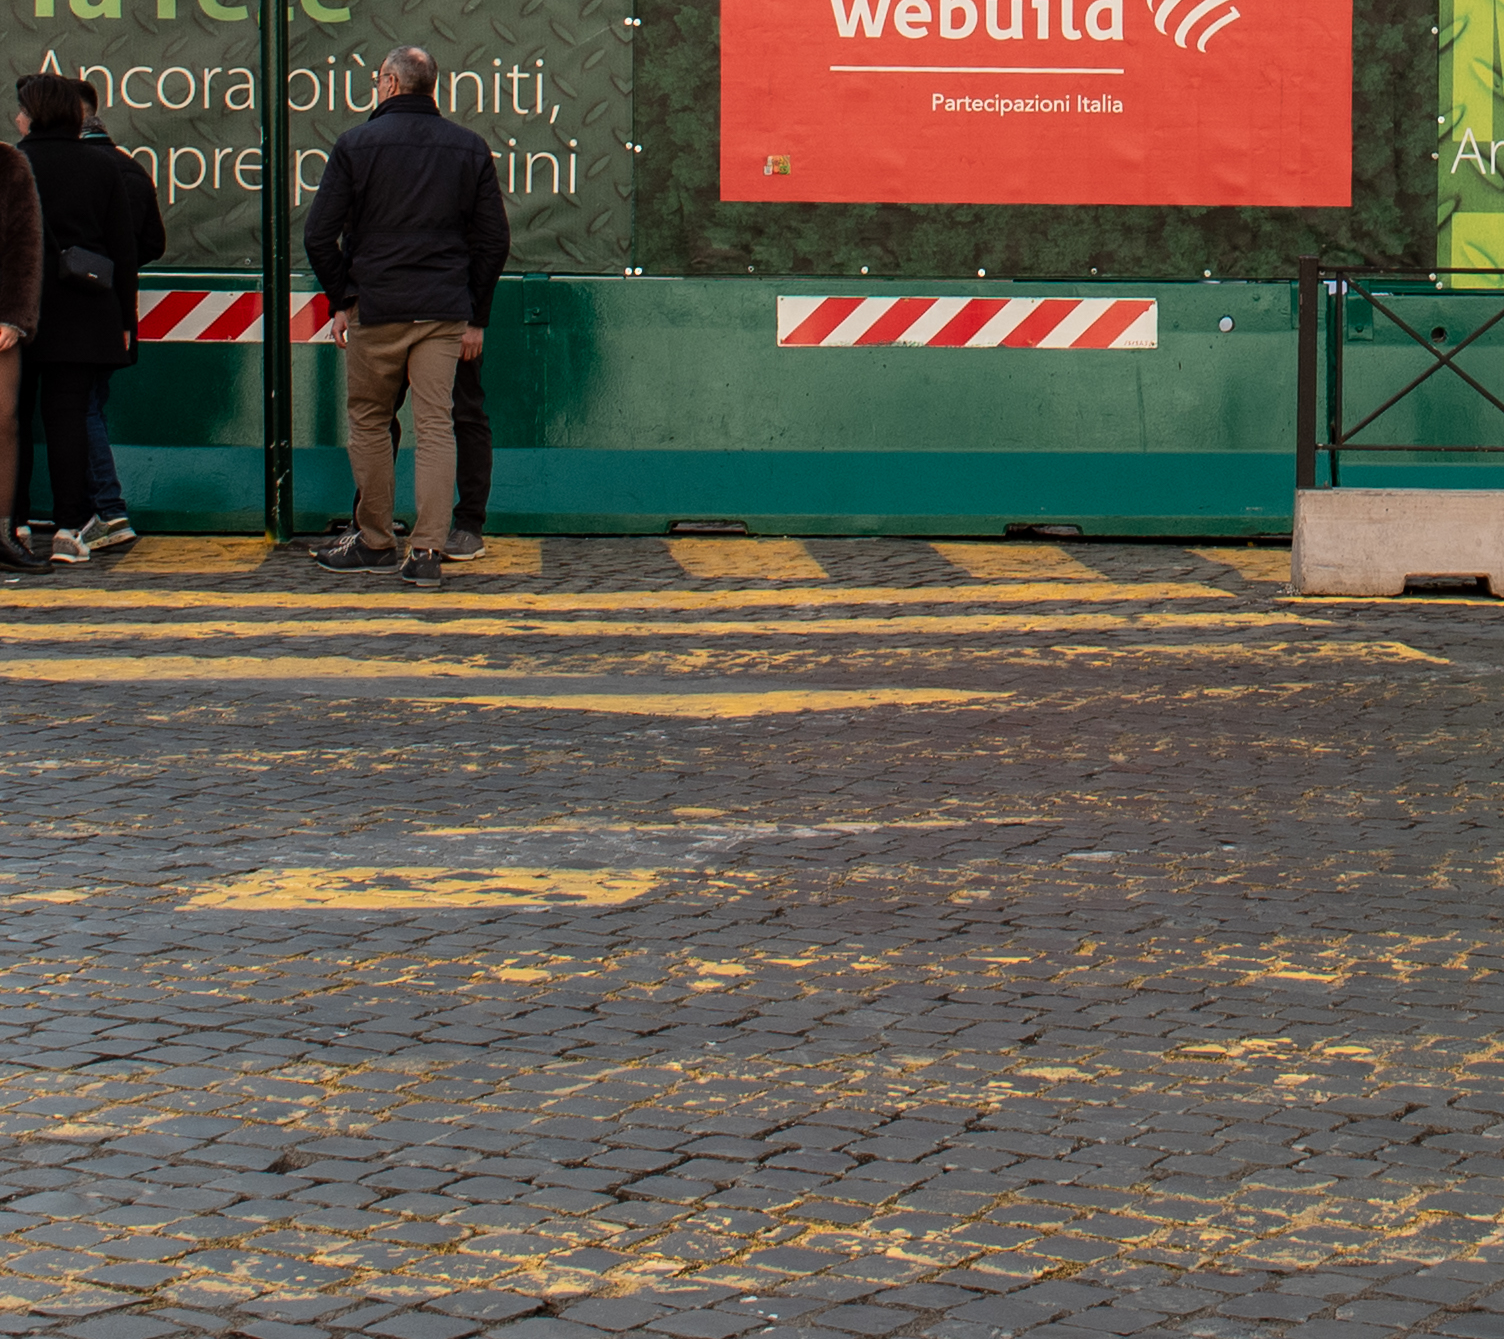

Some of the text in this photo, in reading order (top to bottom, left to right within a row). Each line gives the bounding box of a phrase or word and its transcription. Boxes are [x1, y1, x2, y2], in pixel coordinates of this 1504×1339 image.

[433, 58, 562, 125] niti,
[931, 93, 1124, 116] Partecipazioni Italia
